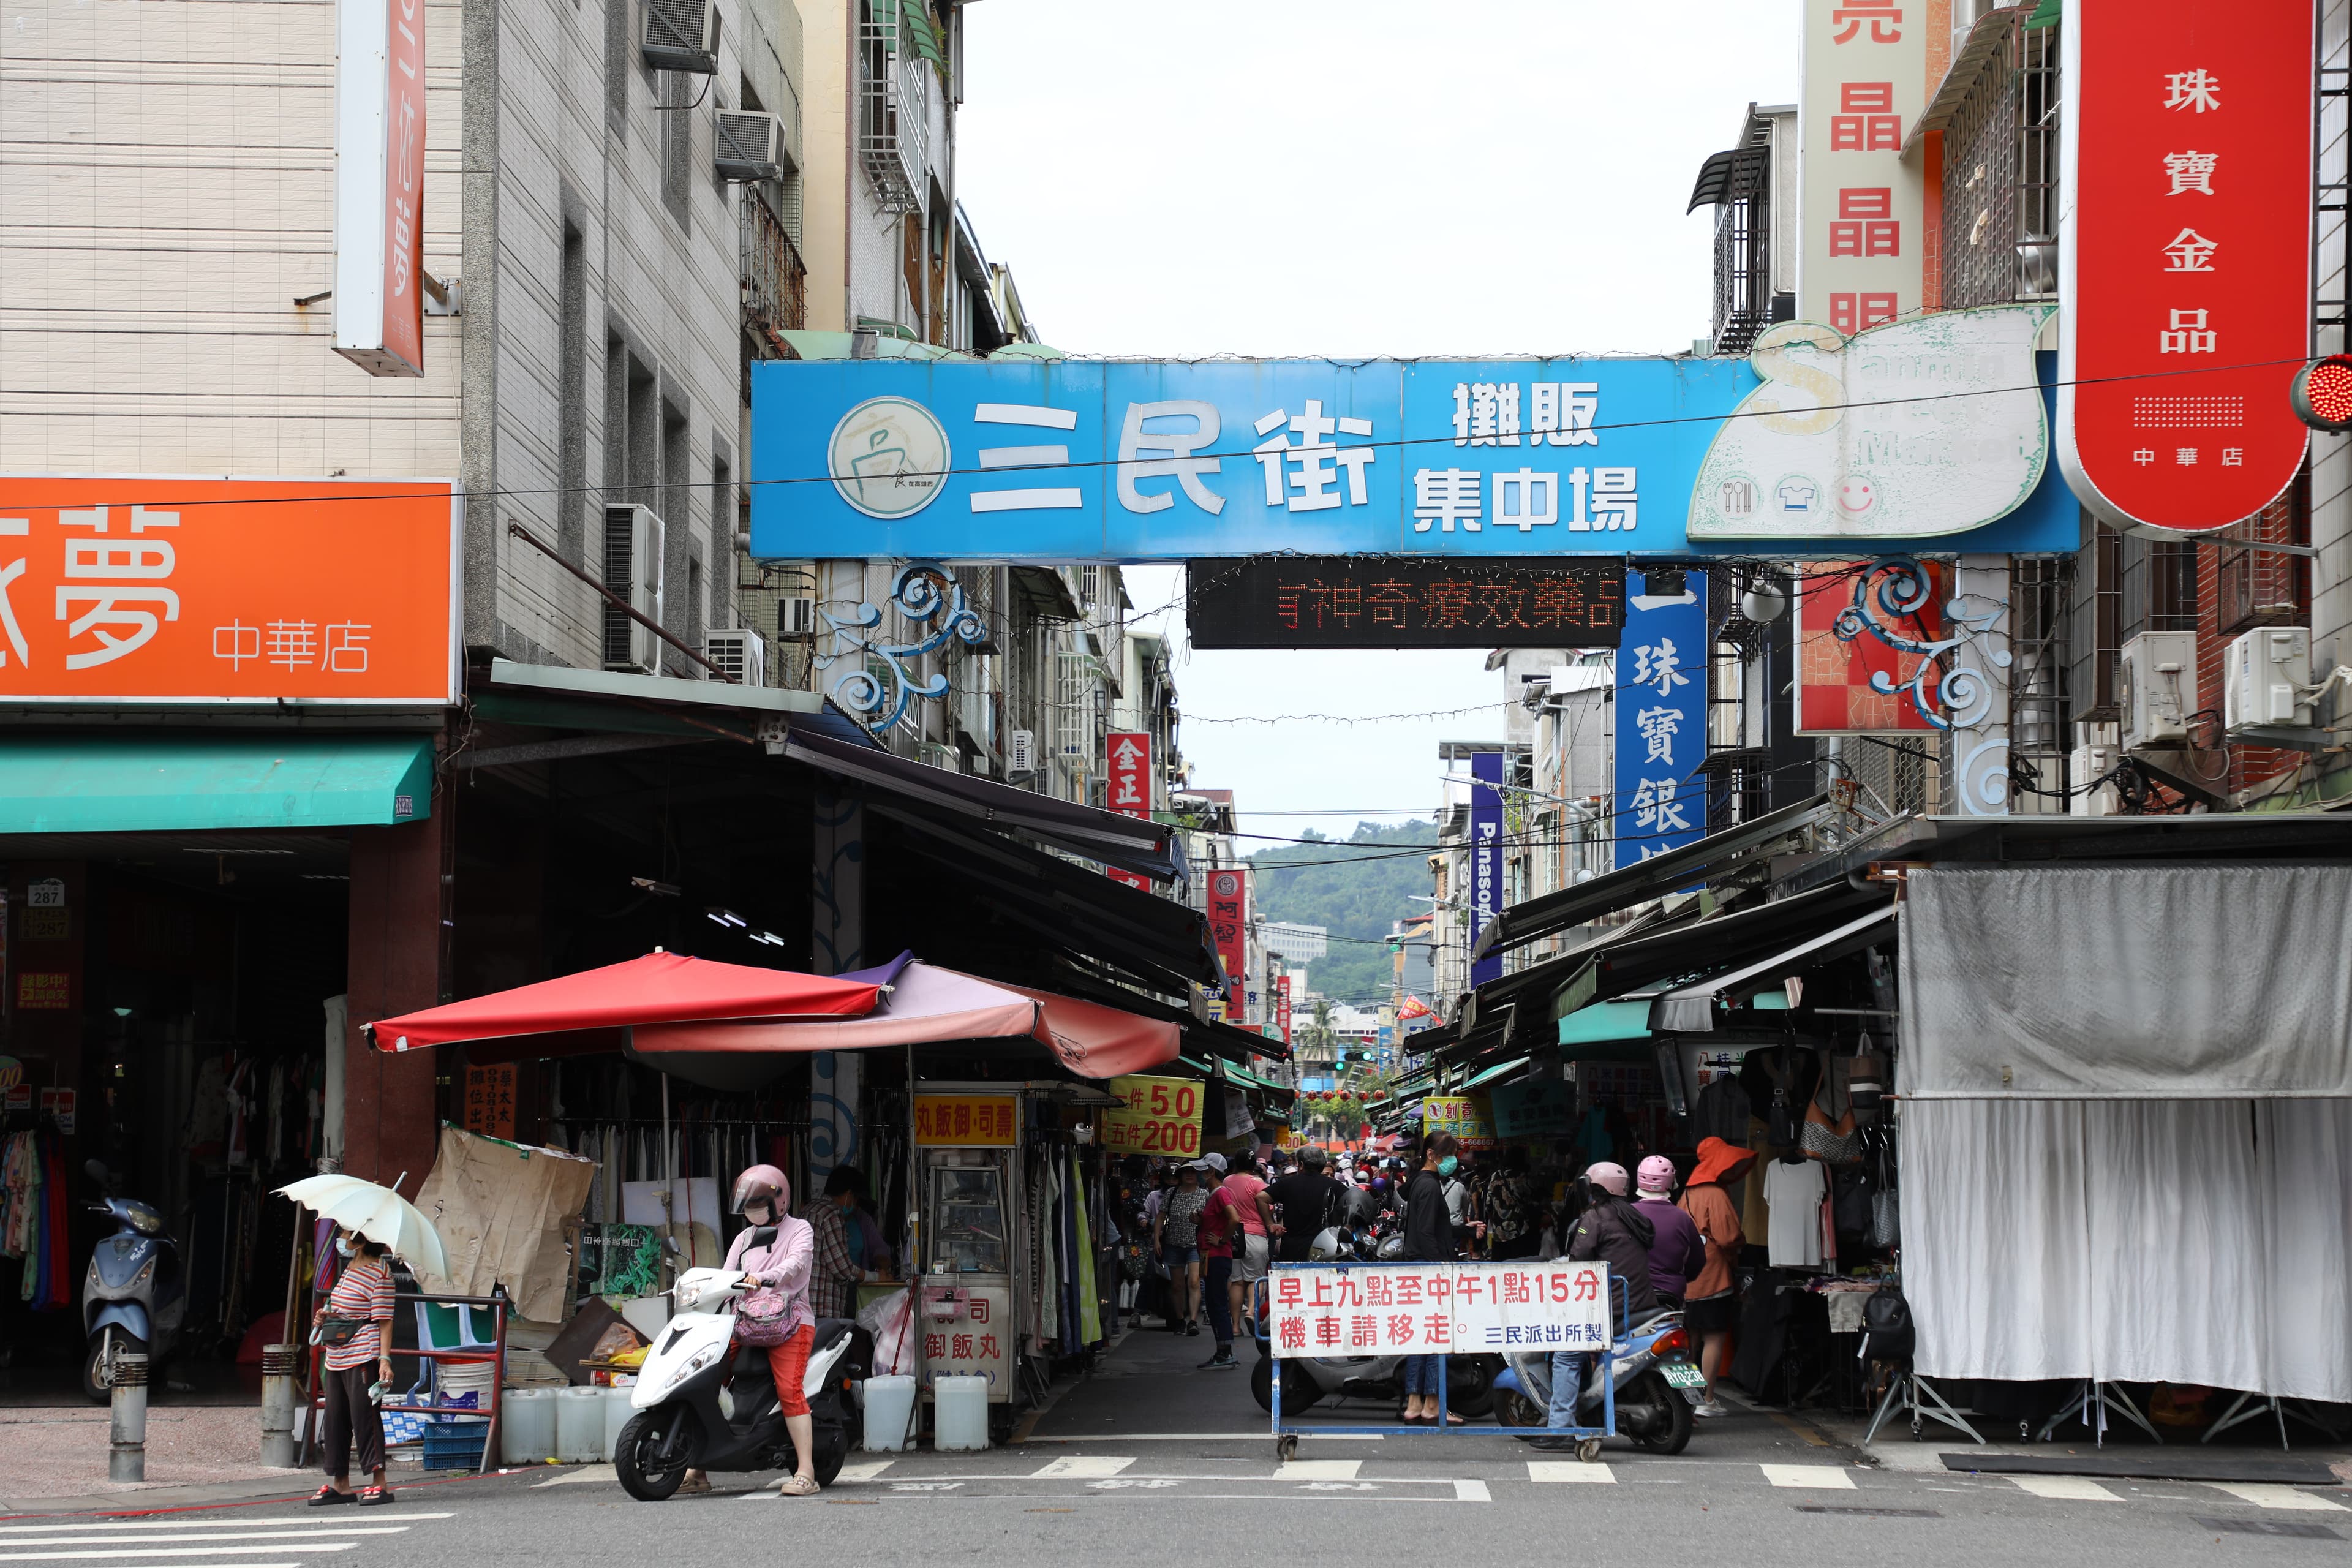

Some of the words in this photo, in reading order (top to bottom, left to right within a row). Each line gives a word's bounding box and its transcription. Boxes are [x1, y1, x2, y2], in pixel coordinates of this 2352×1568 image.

[2160, 67, 2221, 355] 珠寶金品
[1452, 382, 1599, 447] 攤販
[970, 399, 1376, 515] 三民街
[2133, 447, 2243, 467] 中華店
[1413, 467, 1638, 532] 集中場
[0, 504, 181, 671] 夢
[213, 618, 372, 673] 中華店
[1112, 737, 1145, 817] 金正
[34, 892, 58, 903] 287
[1477, 822, 1496, 935] Panasonic
[37, 922, 66, 935] 287
[1697, 1052, 1711, 1093] 八寶
[1150, 1085, 1195, 1118] 50
[1111, 1123, 1141, 1147] 五件
[1142, 1120, 1198, 1153] 200
[1278, 1270, 1600, 1310] 早上九點至中午1點15分
[924, 1333, 1000, 1360] 御飯丸
[1485, 1323, 1603, 1345] 三民派出所製
